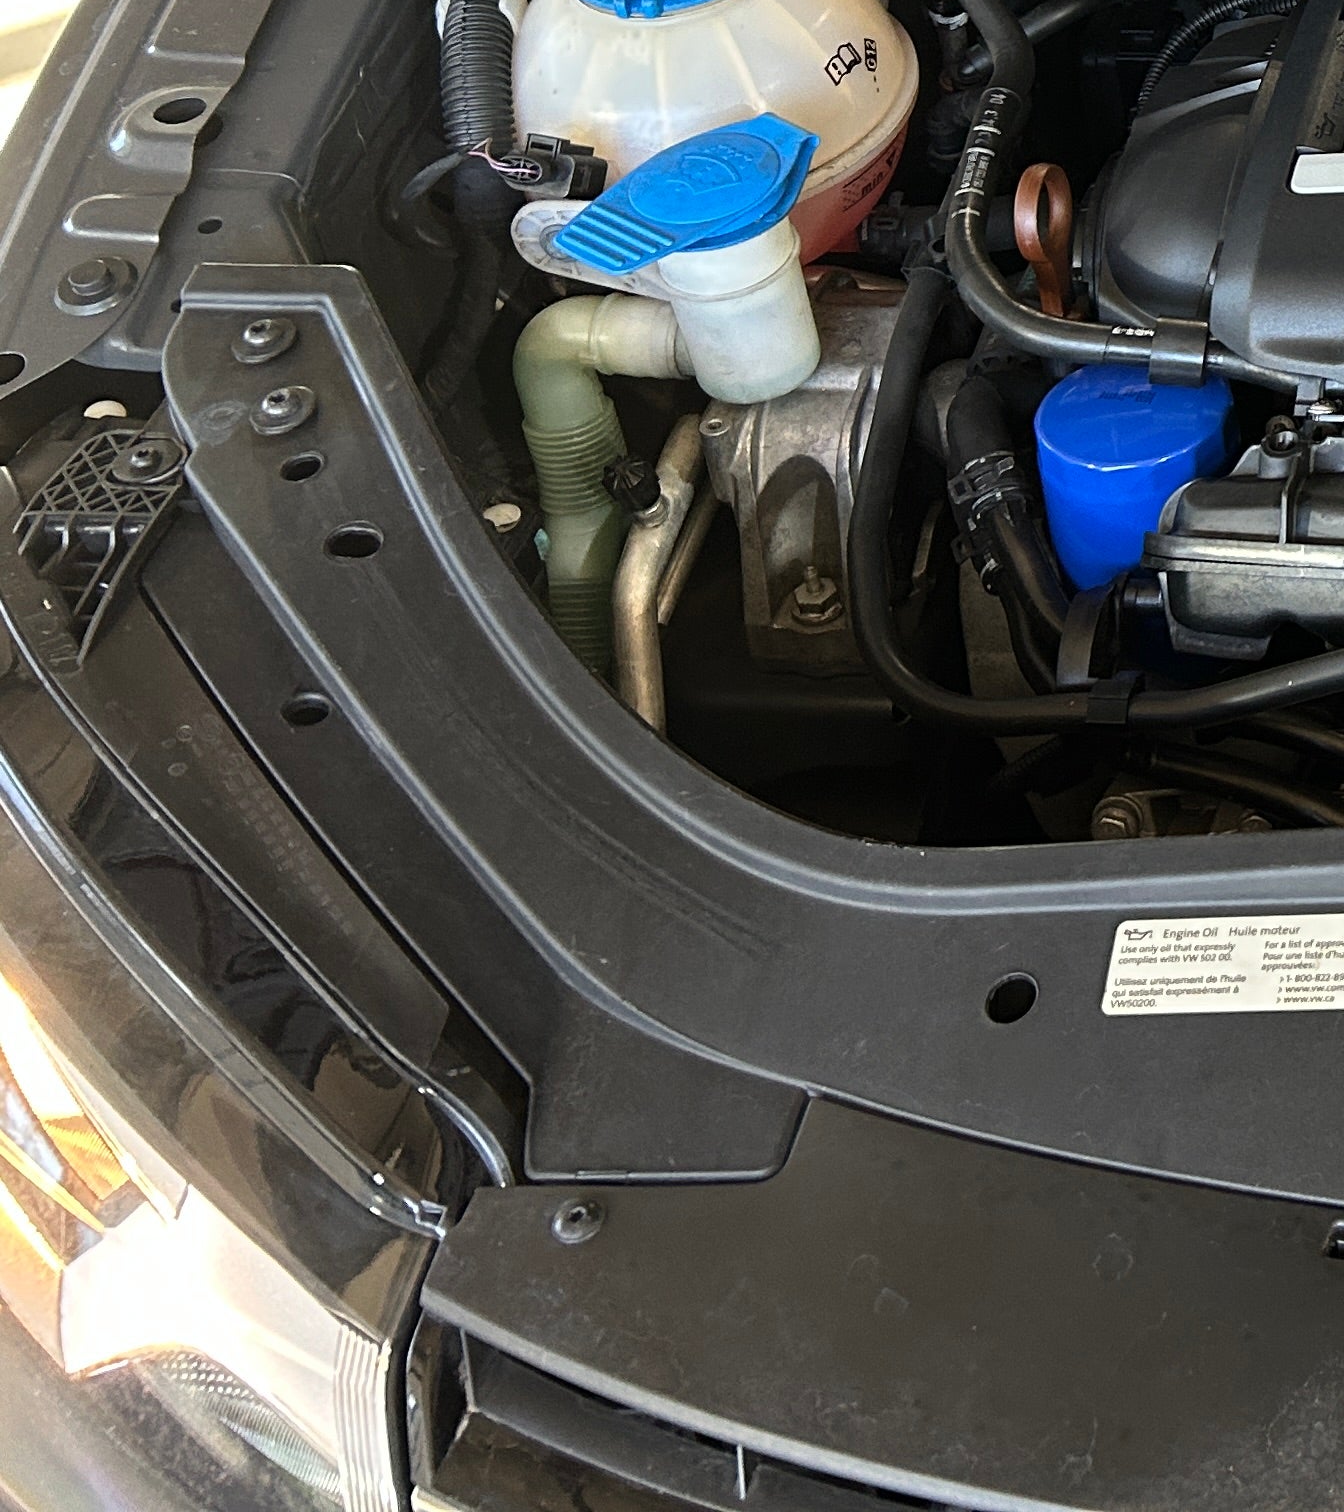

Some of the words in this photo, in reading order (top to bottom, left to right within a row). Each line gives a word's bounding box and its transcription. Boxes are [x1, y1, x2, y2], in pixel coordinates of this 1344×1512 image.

[1163, 928, 1200, 941] Engine
[1202, 927, 1218, 937] Oil
[1229, 926, 1258, 936] Huile
[1260, 926, 1301, 936] moteur
[1121, 945, 1138, 953] Use
[1139, 945, 1159, 954] only
[1160, 944, 1172, 952] oil
[1173, 943, 1192, 951] that
[1193, 942, 1236, 953] expressly
[1264, 941, 1279, 949] For
[1288, 940, 1301, 948] list
[1303, 939, 1314, 948] of
[1118, 955, 1158, 965] complies
[1160, 954, 1180, 963] with
[1182, 954, 1198, 962] VW
[1200, 953, 1216, 962] 502
[1263, 952, 1283, 961] Pour
[1285, 952, 1302, 960] une
[1304, 950, 1324, 959] liste
[1150, 975, 1203, 986] uniquement
[1205, 974, 1217, 983] de
[1283, 995, 1335, 1003] www.vw.ca
